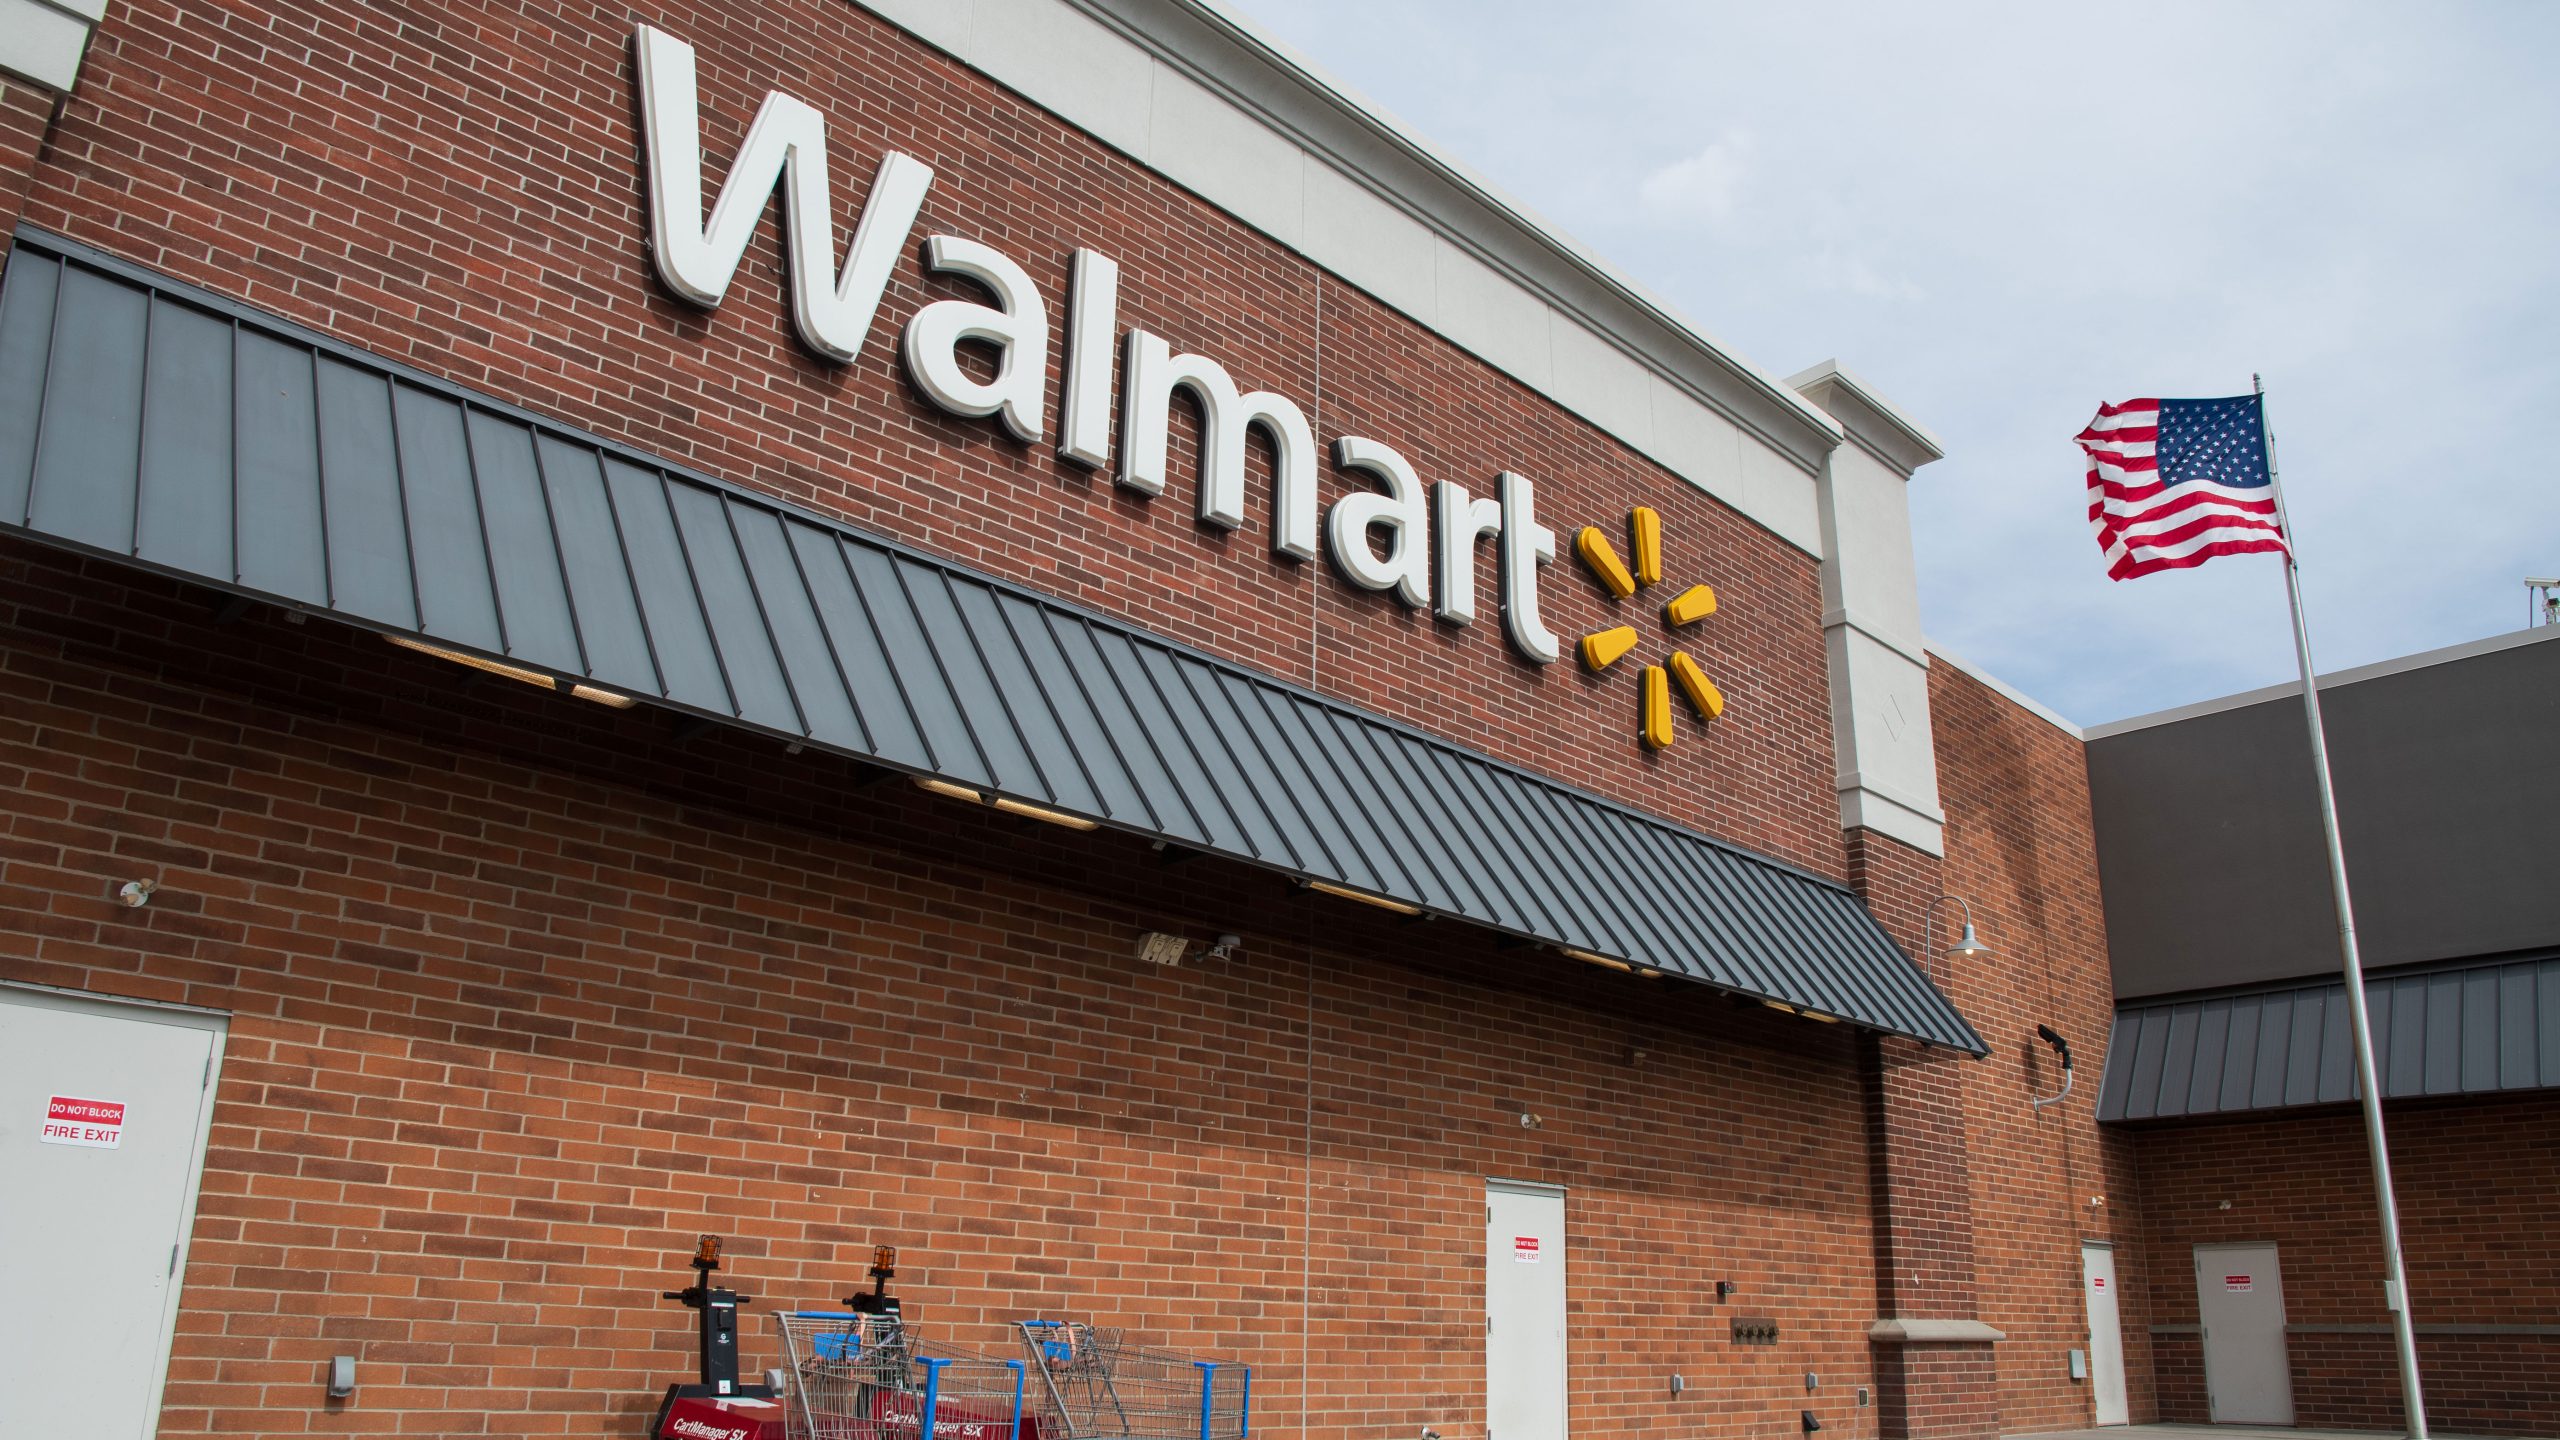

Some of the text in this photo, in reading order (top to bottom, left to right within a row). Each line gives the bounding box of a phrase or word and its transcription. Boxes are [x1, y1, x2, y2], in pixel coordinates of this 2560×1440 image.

[634, 23, 1560, 664] Walmart
[51, 1103, 122, 1119] DO NOT BLOCK
[43, 1124, 120, 1143] FIRE EXIT
[884, 1410, 984, 1437] CartMager SX
[729, 1428, 748, 1440] SX
